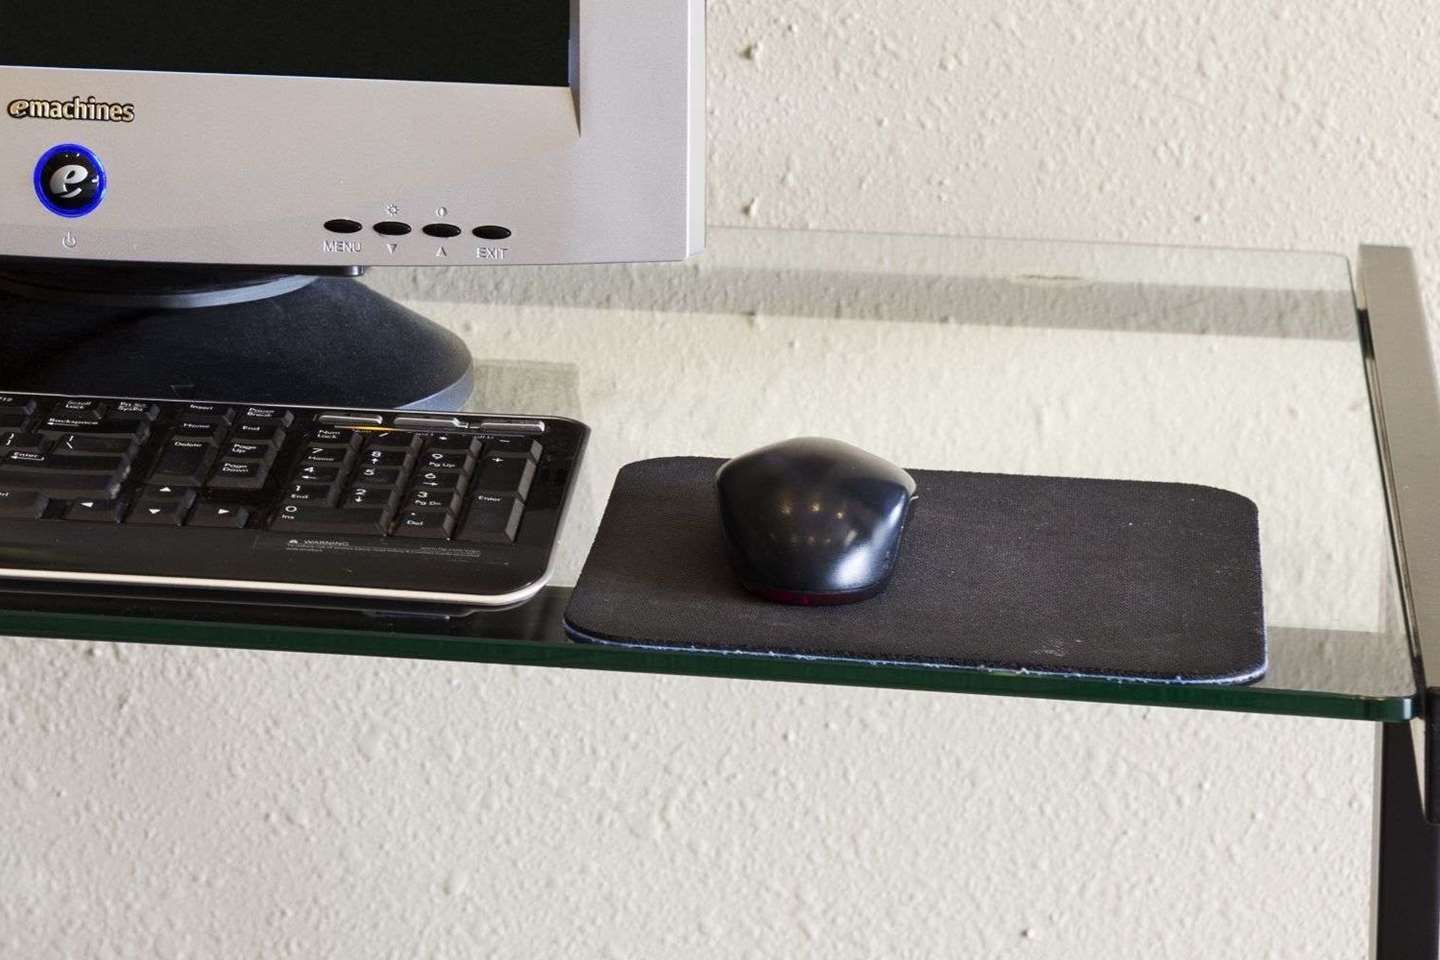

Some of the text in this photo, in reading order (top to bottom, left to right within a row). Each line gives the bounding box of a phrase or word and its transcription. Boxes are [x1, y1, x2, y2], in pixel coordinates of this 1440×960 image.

[8, 96, 135, 123] emachines
[322, 241, 361, 253] MENU
[476, 247, 508, 259] EXIT
